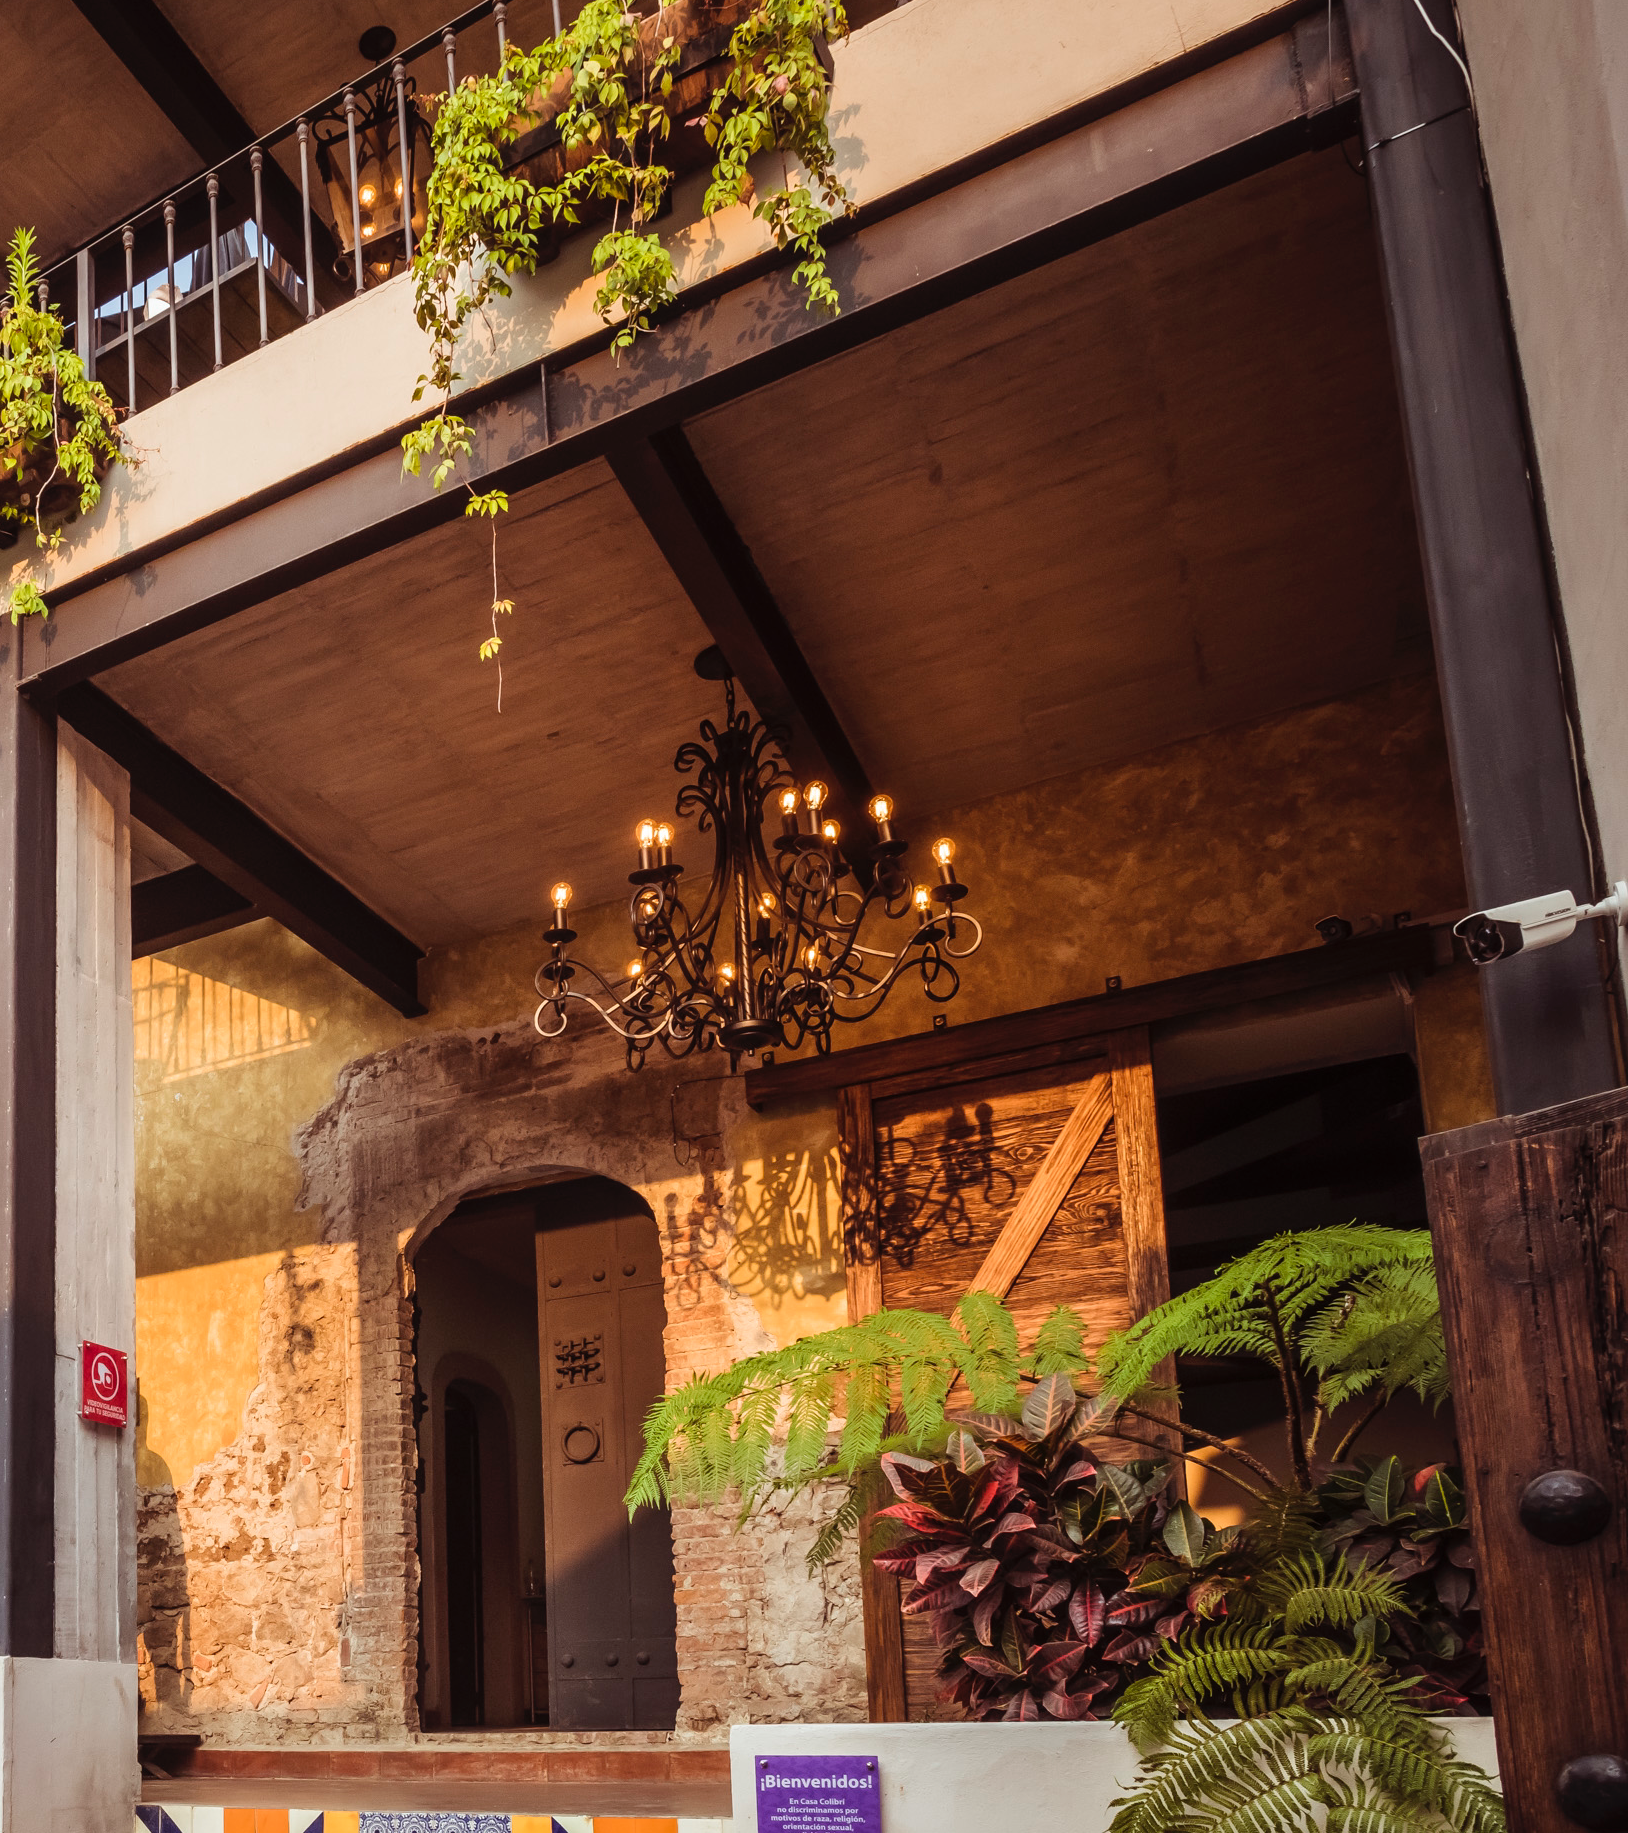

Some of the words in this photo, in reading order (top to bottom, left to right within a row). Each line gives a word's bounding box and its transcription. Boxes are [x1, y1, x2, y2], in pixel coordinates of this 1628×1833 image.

[760, 1774, 873, 1791] ¡Bienvenidos!
[789, 1797, 798, 1805] En
[800, 1797, 818, 1805] Casa
[788, 1806, 844, 1814] discriminamos
[770, 1814, 801, 1822] motivos
[802, 1814, 812, 1822] de
[813, 1815, 832, 1823] raza,
[833, 1815, 866, 1824] religión,
[782, 1823, 826, 1831] orientación
